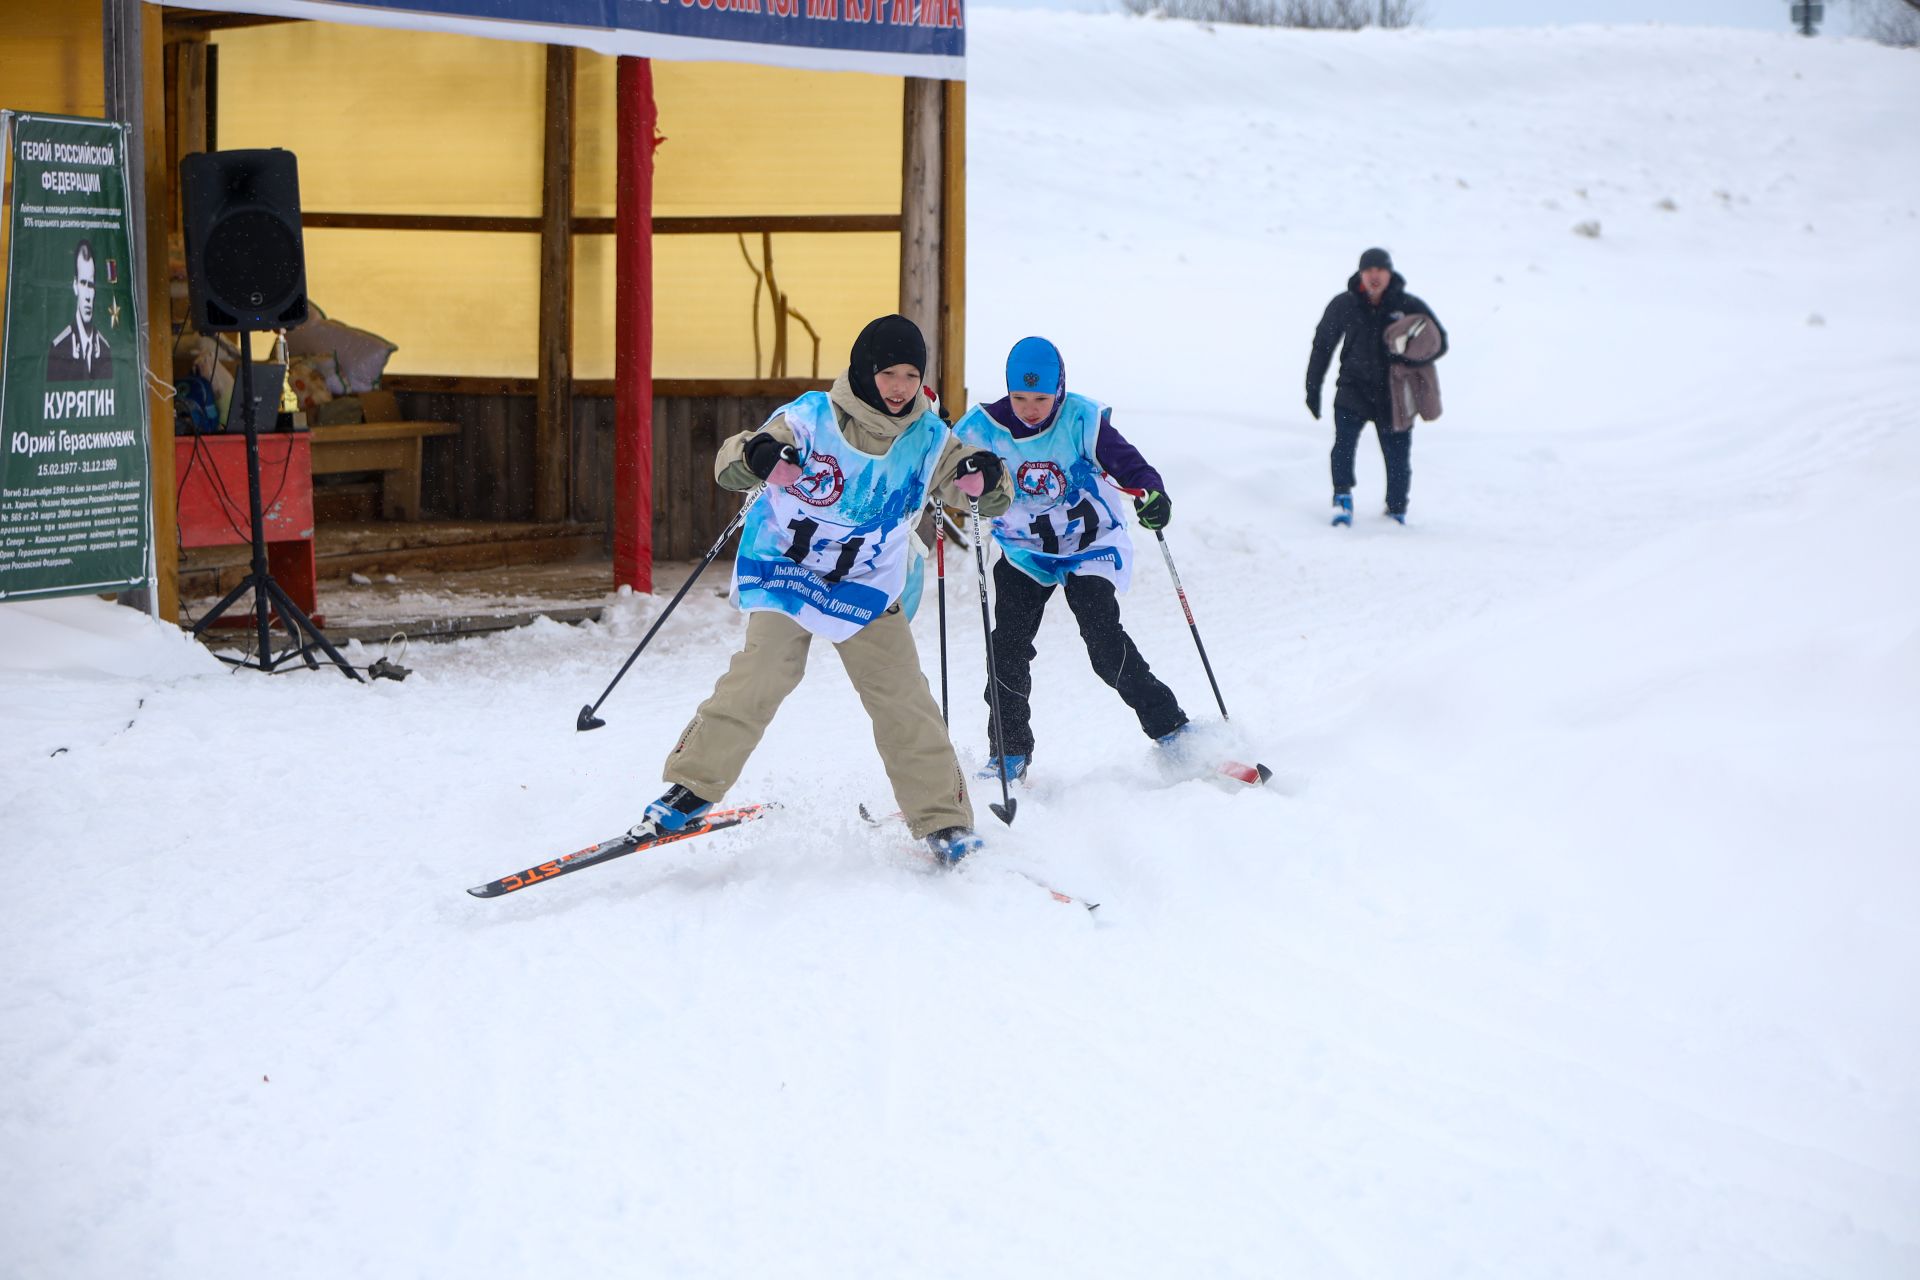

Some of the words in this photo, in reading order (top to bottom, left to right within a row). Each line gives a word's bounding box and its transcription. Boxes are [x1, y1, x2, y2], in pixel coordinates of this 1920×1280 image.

[21, 138, 52, 162] ГЕРОЙ
[54, 141, 115, 166] РОССИЙСКОЙ
[41, 171, 101, 195] ФЕДЕРАЦИИ
[44, 388, 115, 419] КУРЯГИН
[11, 430, 56, 458] Юрий
[58, 429, 137, 455] Герасимович
[37, 461, 77, 476] 15.02.1977
[82, 458, 118, 473] 31.12.1999
[973, 514, 981, 545] NORDWAY
[773, 564, 810, 579] Лыжная
[501, 860, 561, 892] STC
